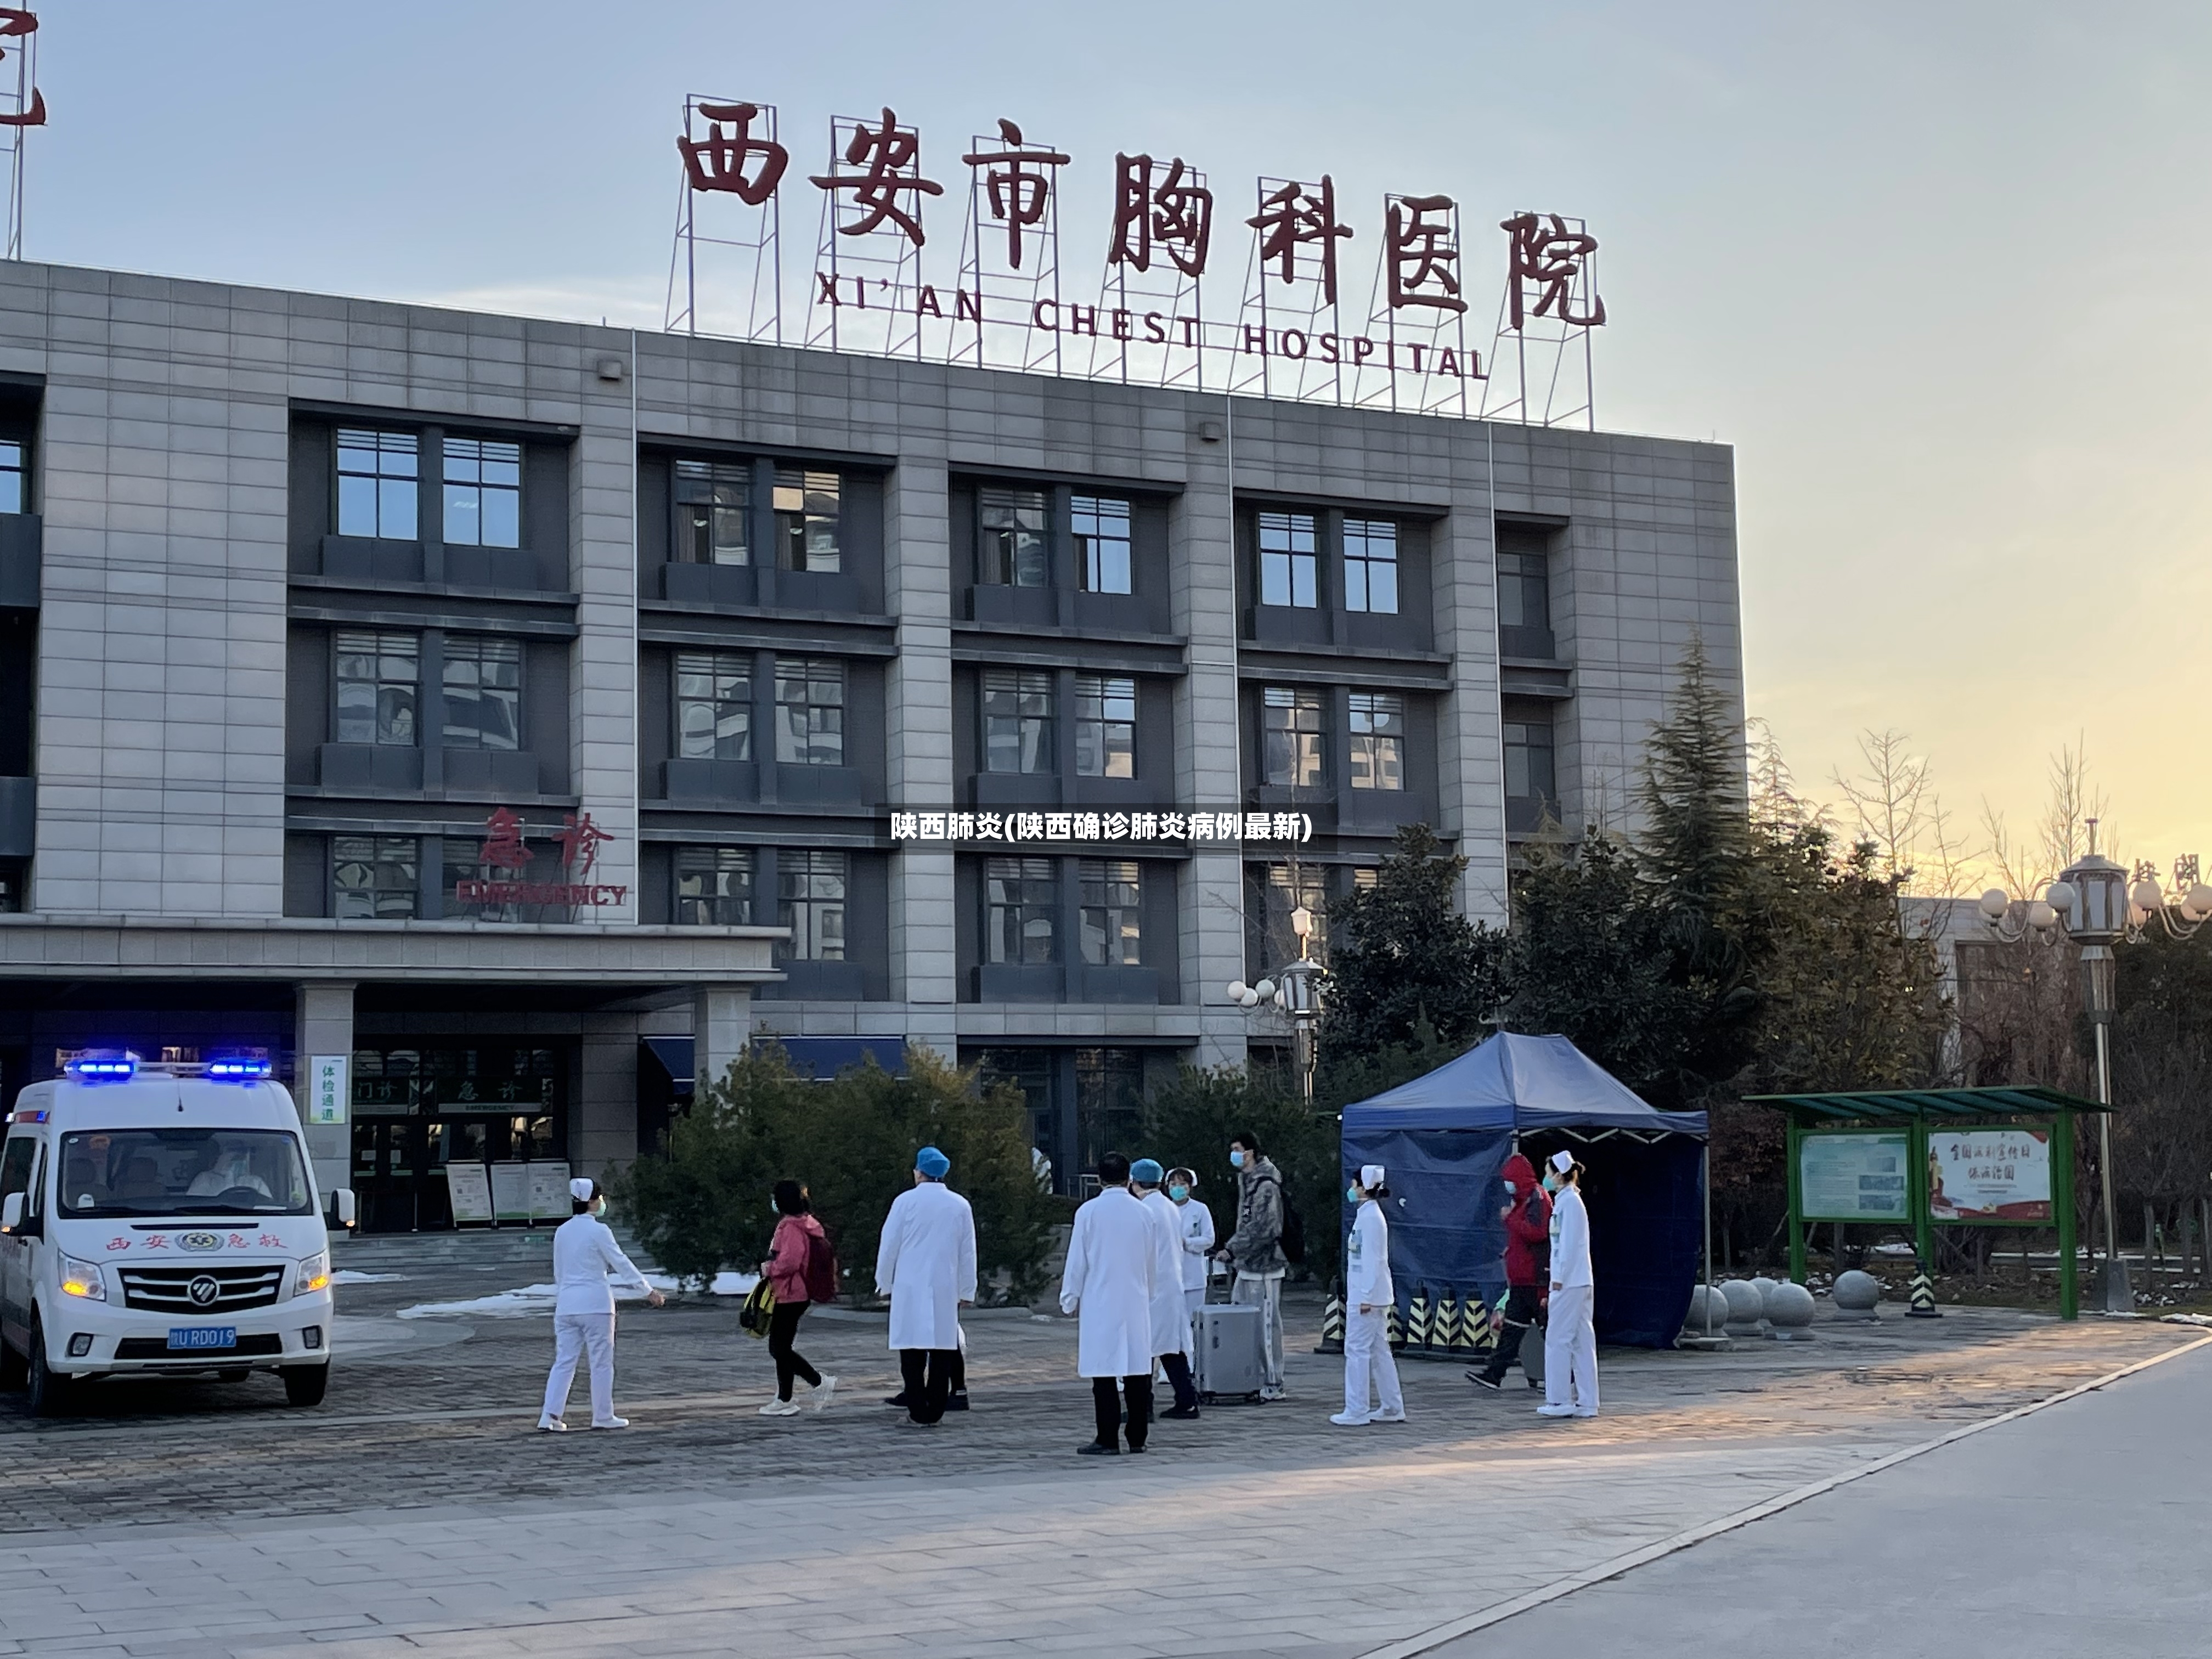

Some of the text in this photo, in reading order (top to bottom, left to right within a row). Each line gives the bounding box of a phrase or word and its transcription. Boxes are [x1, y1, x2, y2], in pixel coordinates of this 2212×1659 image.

[677, 103, 1607, 330] 西安市胸科医院
[1034, 298, 1200, 347] CHEST
[1244, 324, 1489, 380] HOSPITAL
[321, 1065, 335, 1121] 体检通道
[106, 1233, 287, 1250] 西安 急救
